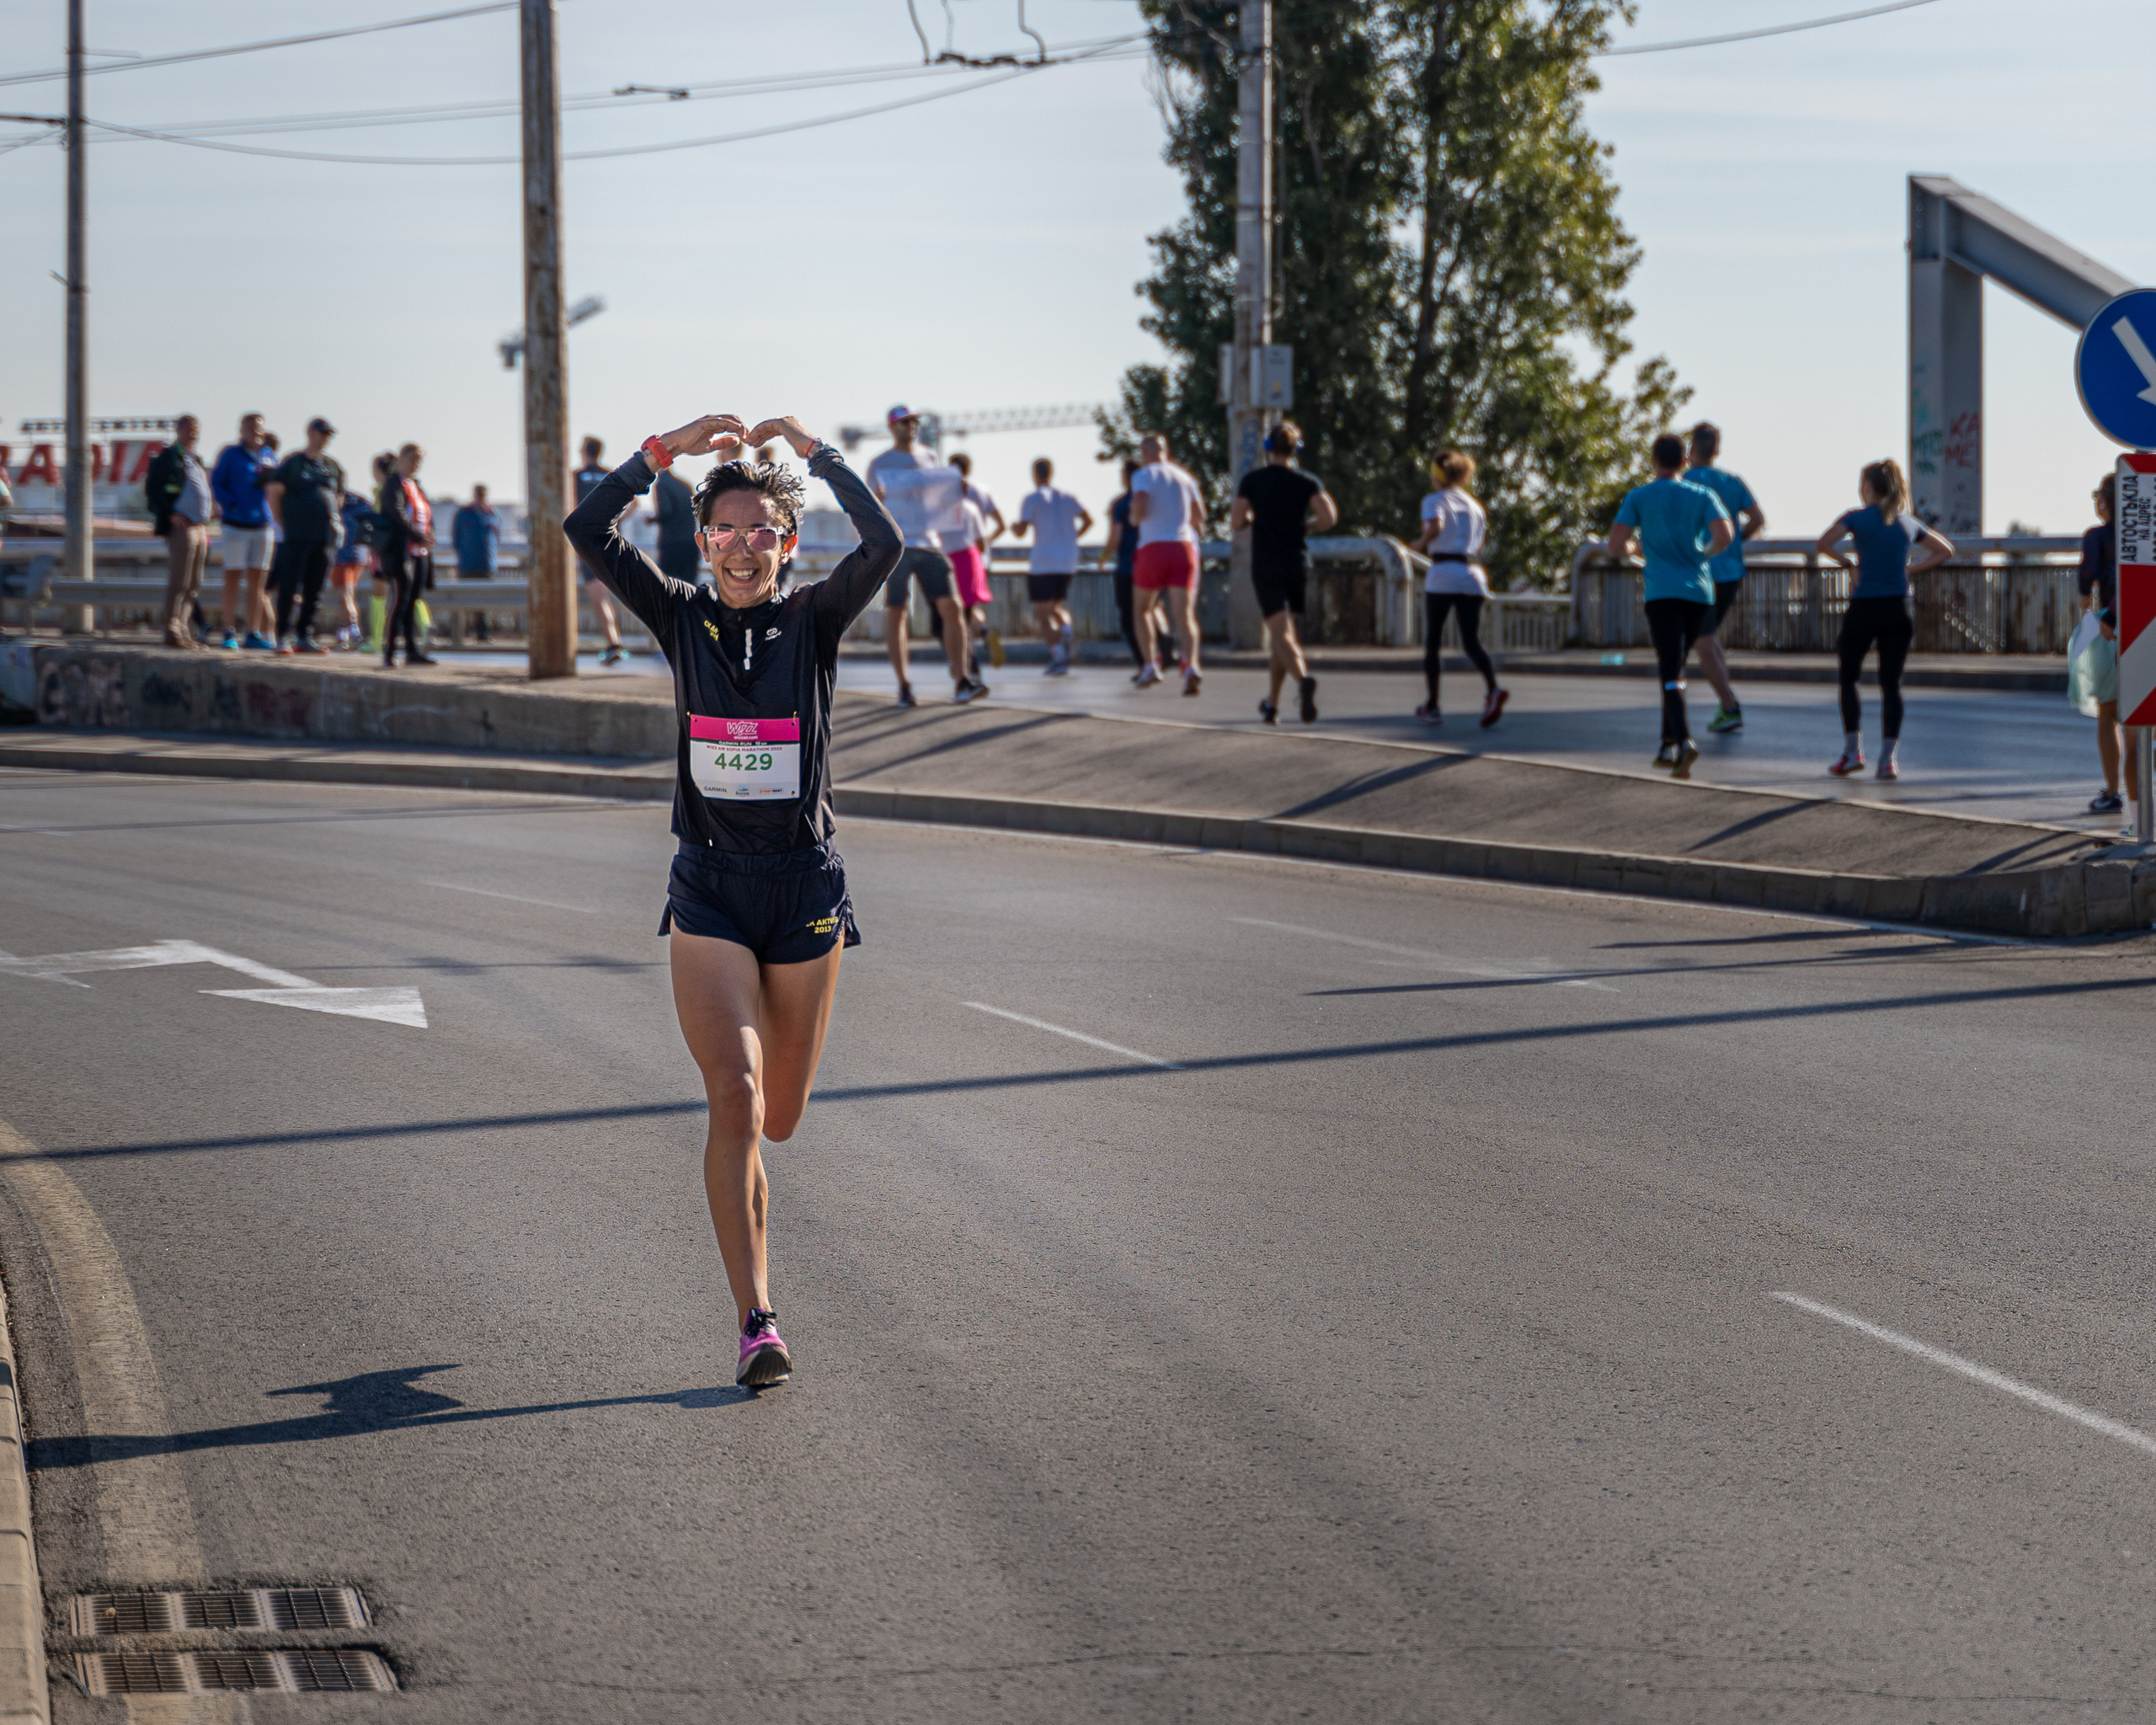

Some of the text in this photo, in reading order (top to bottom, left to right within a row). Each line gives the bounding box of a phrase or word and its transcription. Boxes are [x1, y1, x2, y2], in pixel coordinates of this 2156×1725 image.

[2120, 474, 2138, 563] АВТОСТЪКЛА
[2137, 495, 2152, 542] НА АДРЕС
[714, 753, 772, 771] 4429
[814, 925, 831, 933] 2013
